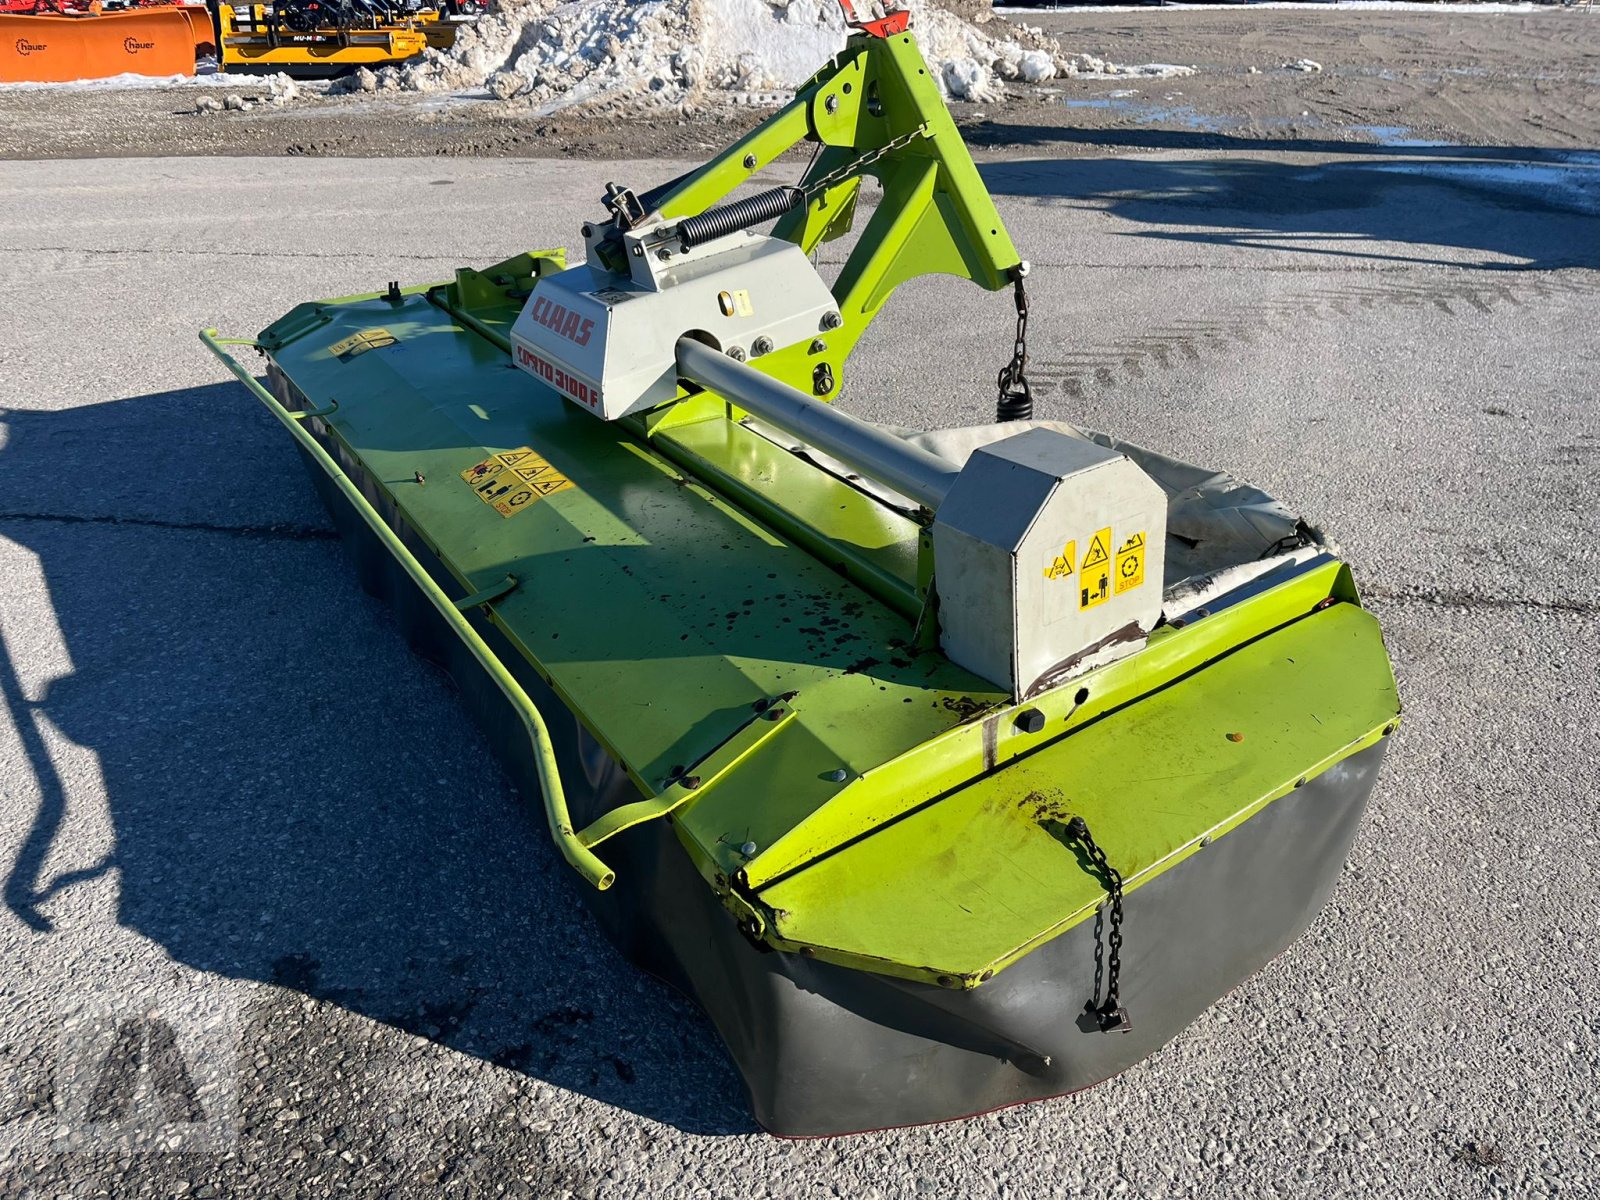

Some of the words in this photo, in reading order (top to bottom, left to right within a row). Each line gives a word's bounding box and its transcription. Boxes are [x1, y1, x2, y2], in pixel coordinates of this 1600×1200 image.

[21, 43, 47, 51] hauer
[129, 41, 155, 49] hauer
[531, 296, 595, 347] CLAAS
[555, 369, 588, 403] 3100
[590, 389, 598, 408] F
[495, 502, 511, 515] STOP
[1119, 576, 1140, 590] STOP
